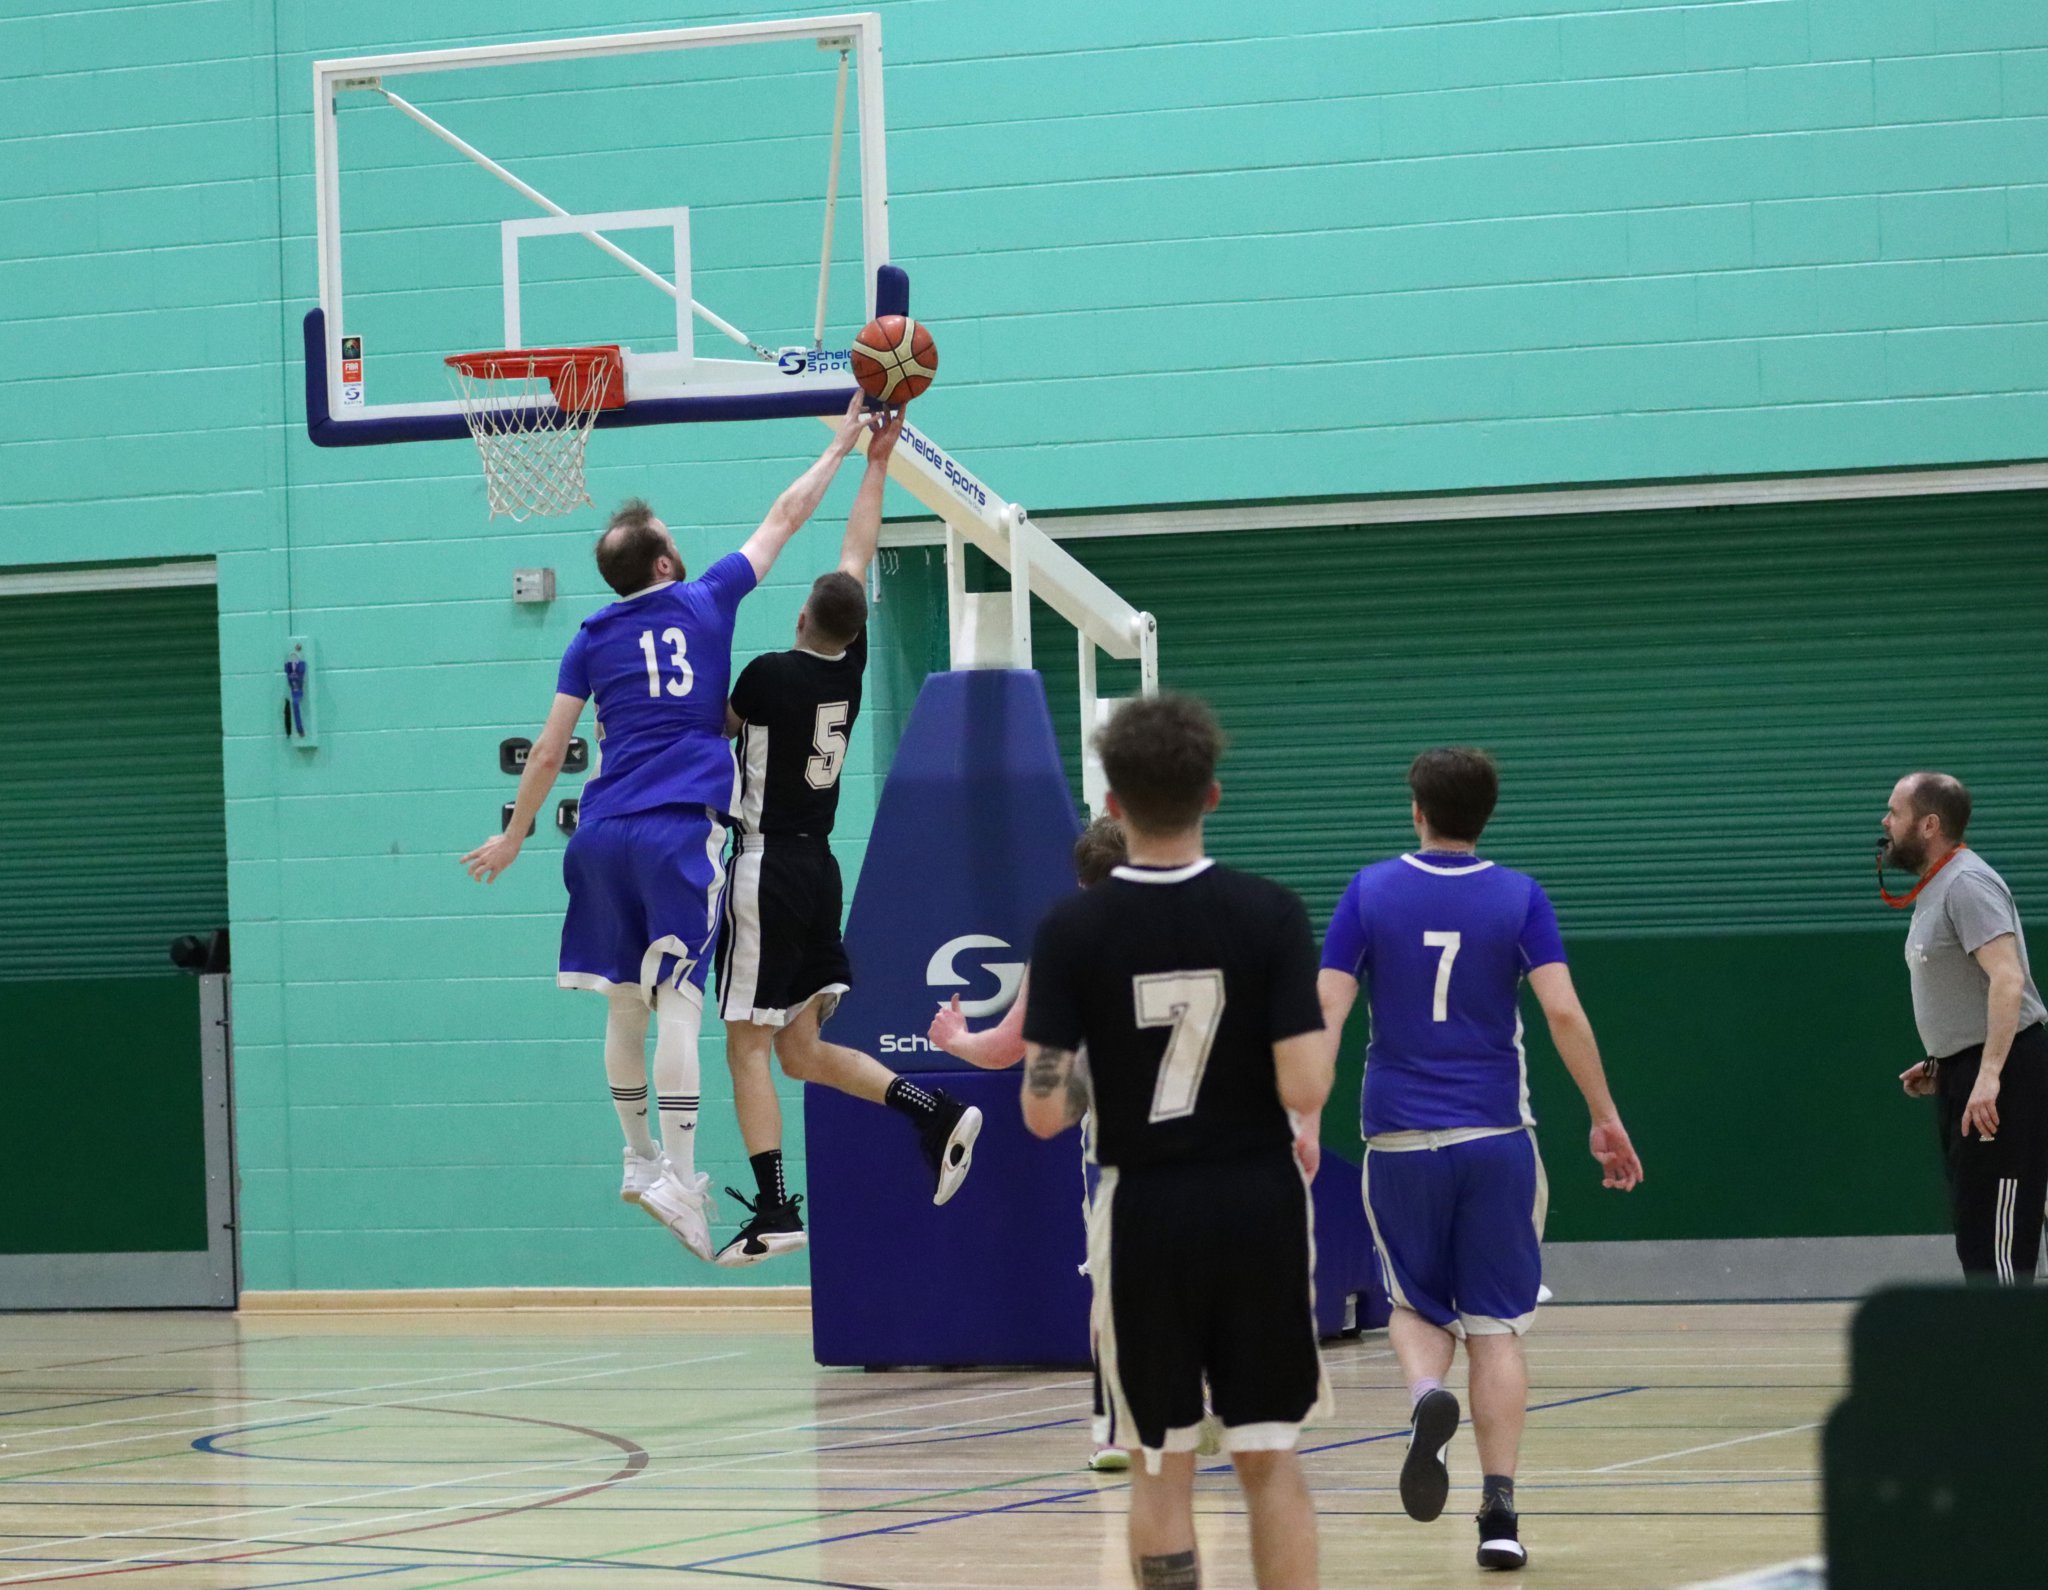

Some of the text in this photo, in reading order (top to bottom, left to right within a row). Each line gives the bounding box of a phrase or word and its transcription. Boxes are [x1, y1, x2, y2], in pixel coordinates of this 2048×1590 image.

[807, 361, 849, 374] Spor
[899, 426, 943, 470] chelde
[944, 460, 986, 506] Sports
[637, 626, 695, 699] 13
[804, 700, 850, 791] 5
[1422, 930, 1462, 1023] 7
[1132, 967, 1226, 1125] 7
